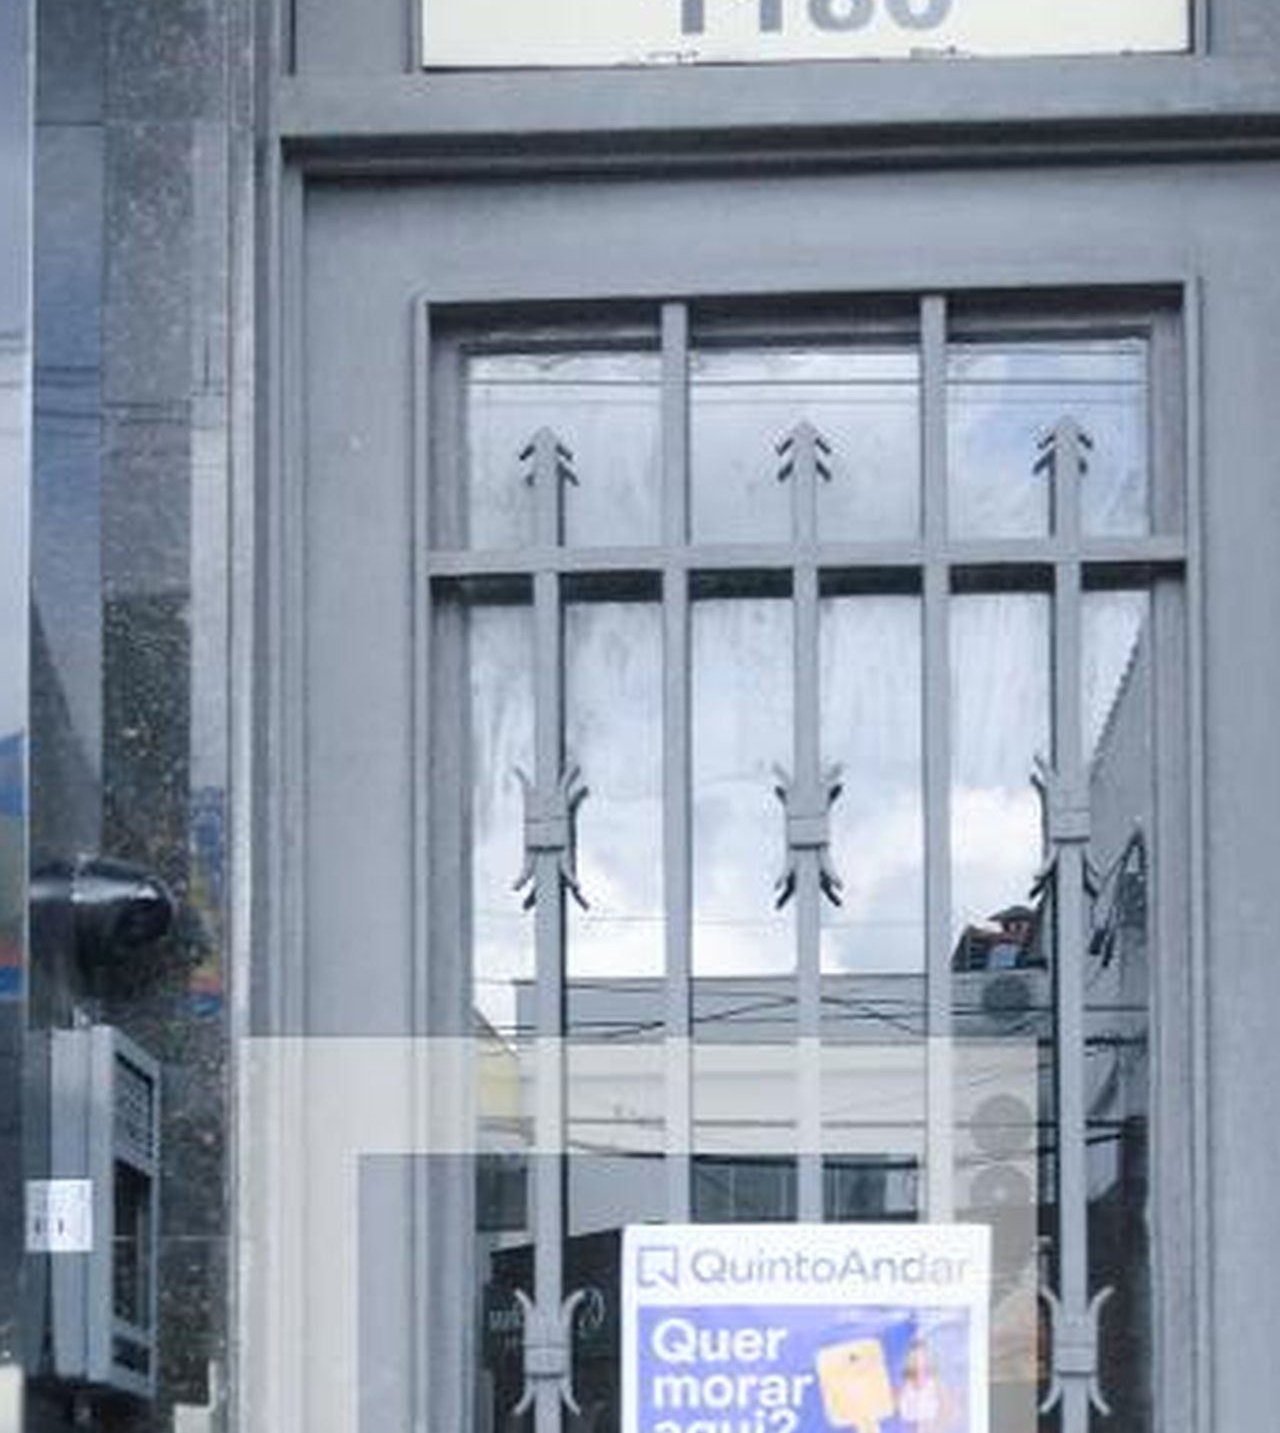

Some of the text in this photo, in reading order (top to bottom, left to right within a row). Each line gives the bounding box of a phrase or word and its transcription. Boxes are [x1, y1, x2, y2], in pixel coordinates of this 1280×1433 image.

[690, 1247, 969, 1287] QuintoAndar
[651, 1318, 789, 1363] Quer
[653, 1372, 814, 1409] morar
